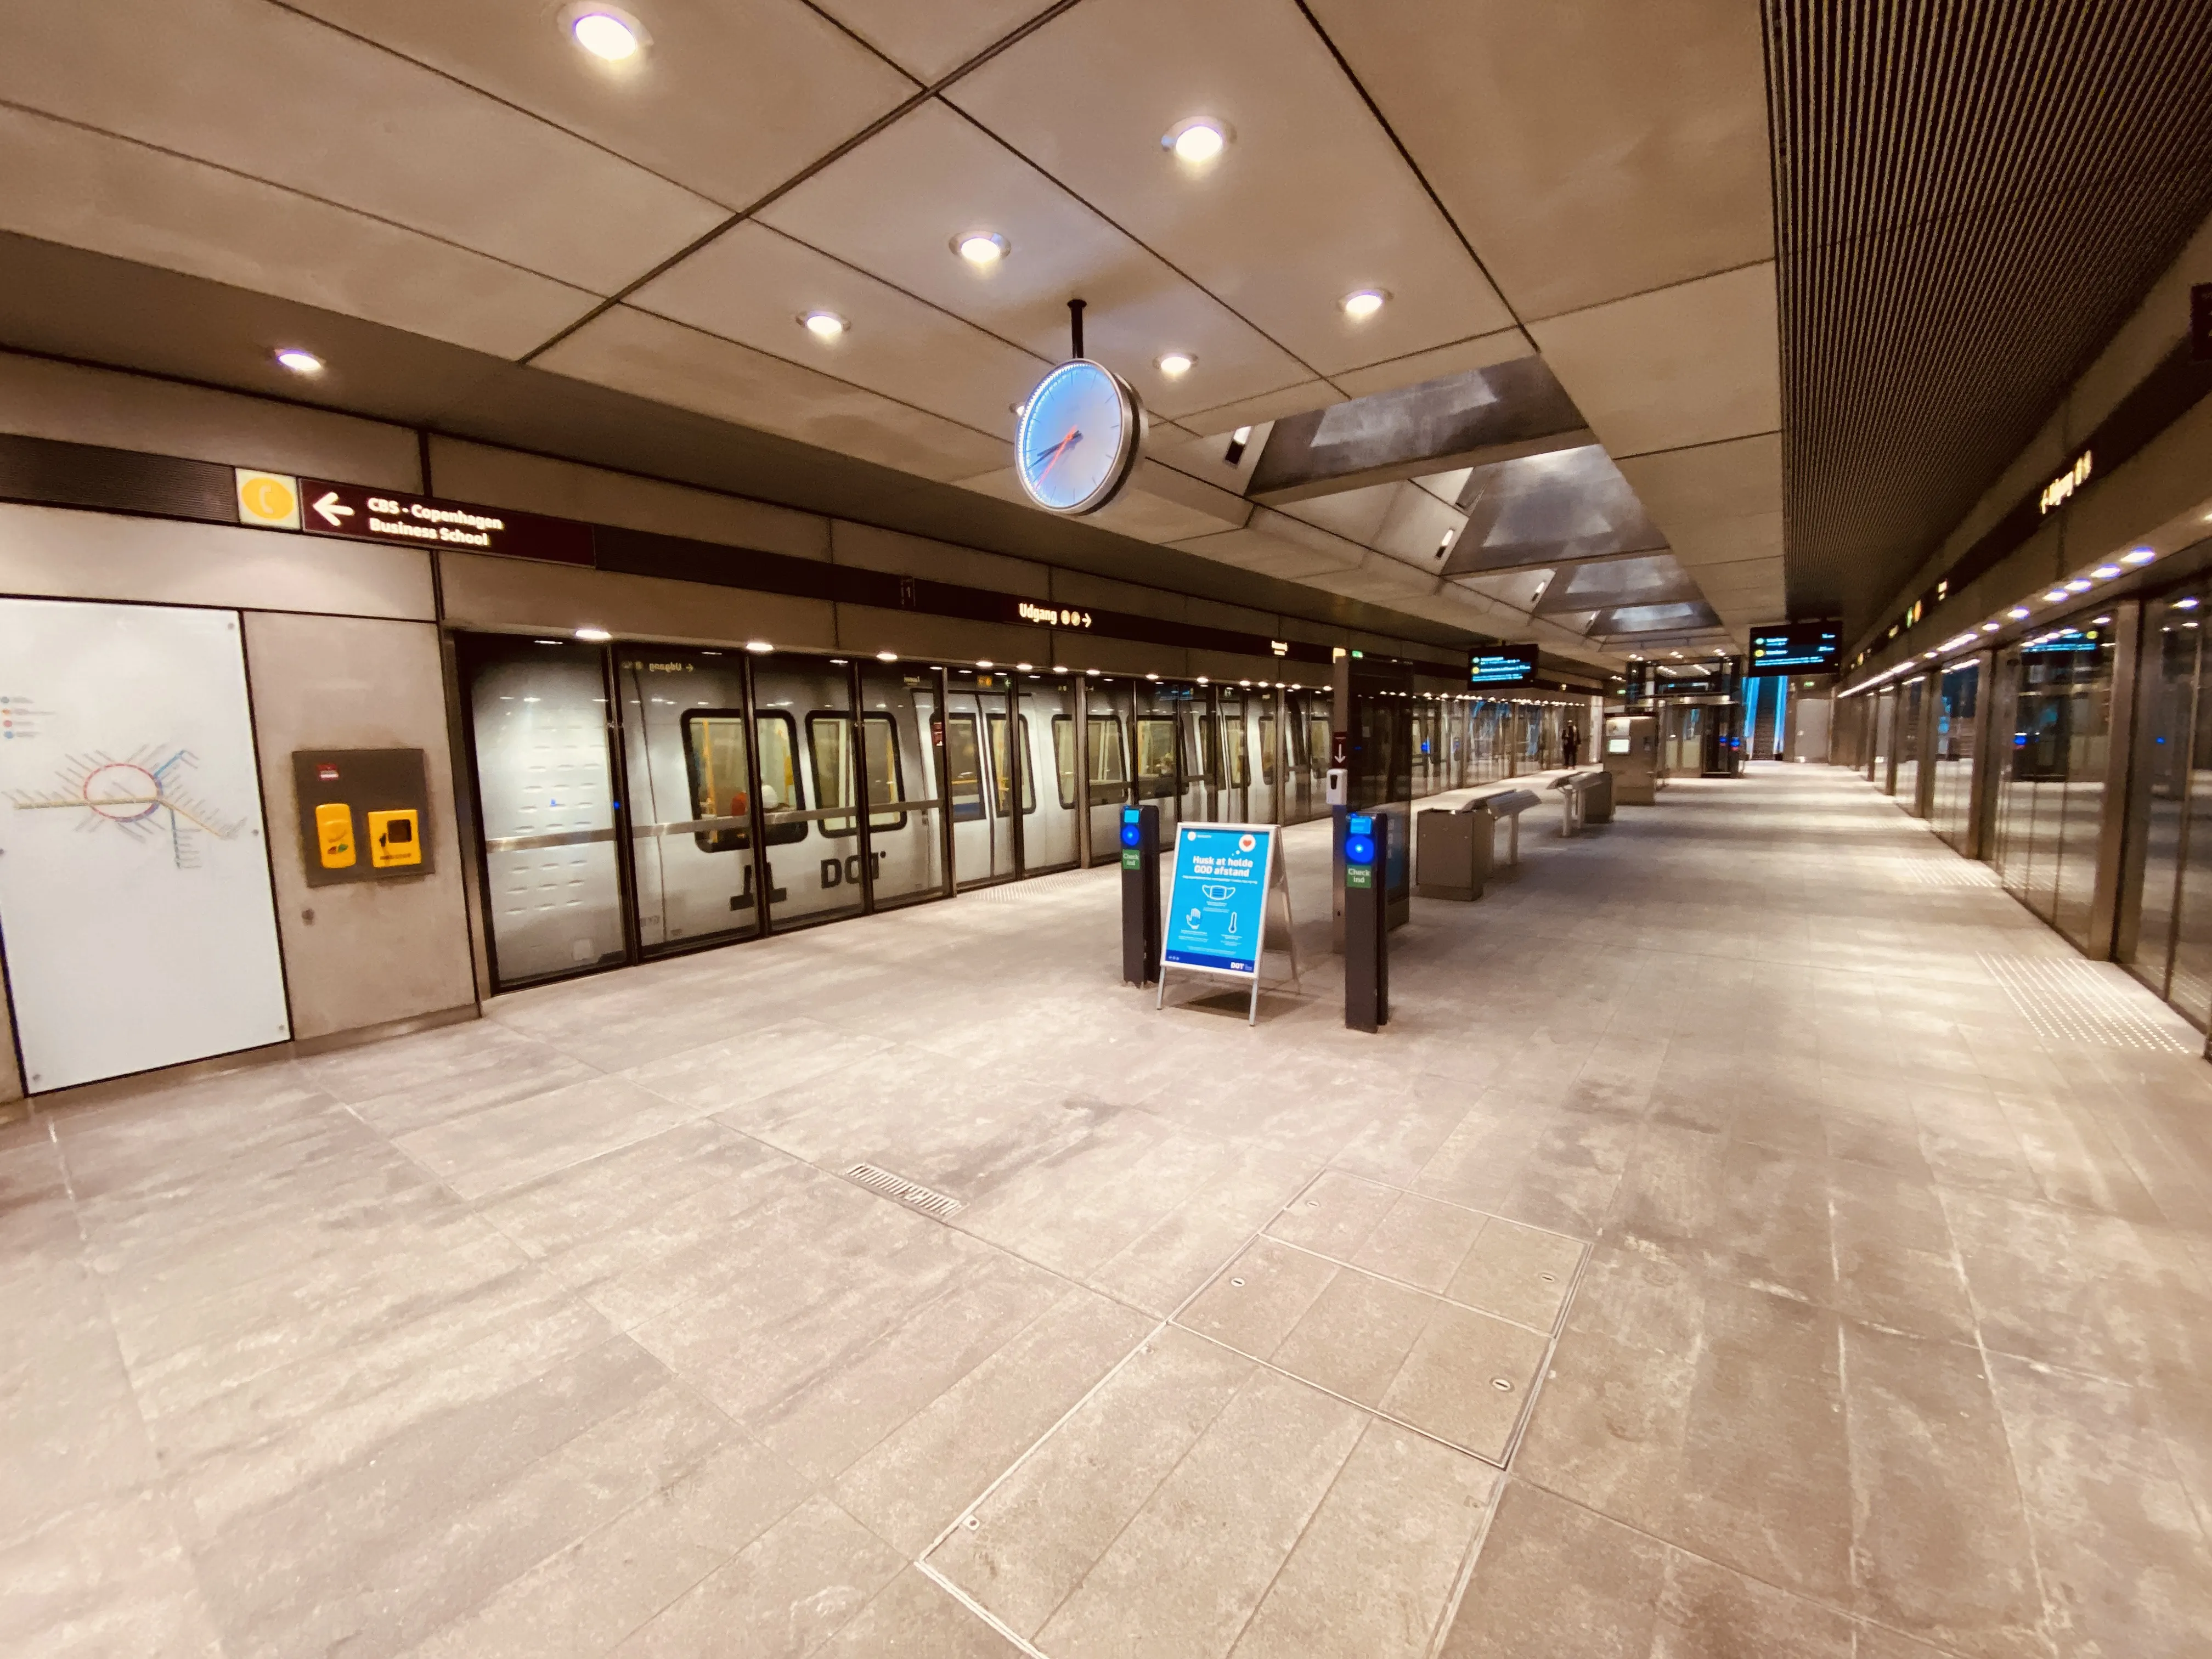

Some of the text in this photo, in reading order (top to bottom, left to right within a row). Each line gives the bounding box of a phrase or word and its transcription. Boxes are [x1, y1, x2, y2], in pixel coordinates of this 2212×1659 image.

[368, 498, 399, 515] CBS
[411, 504, 504, 529] Copenhagen
[369, 517, 489, 546] Business School
[1019, 603, 1058, 625] Udgang
[1193, 855, 1254, 868] Husk at holde
[1194, 865, 1250, 877] GOD afstand
[1348, 868, 1370, 876] Check
